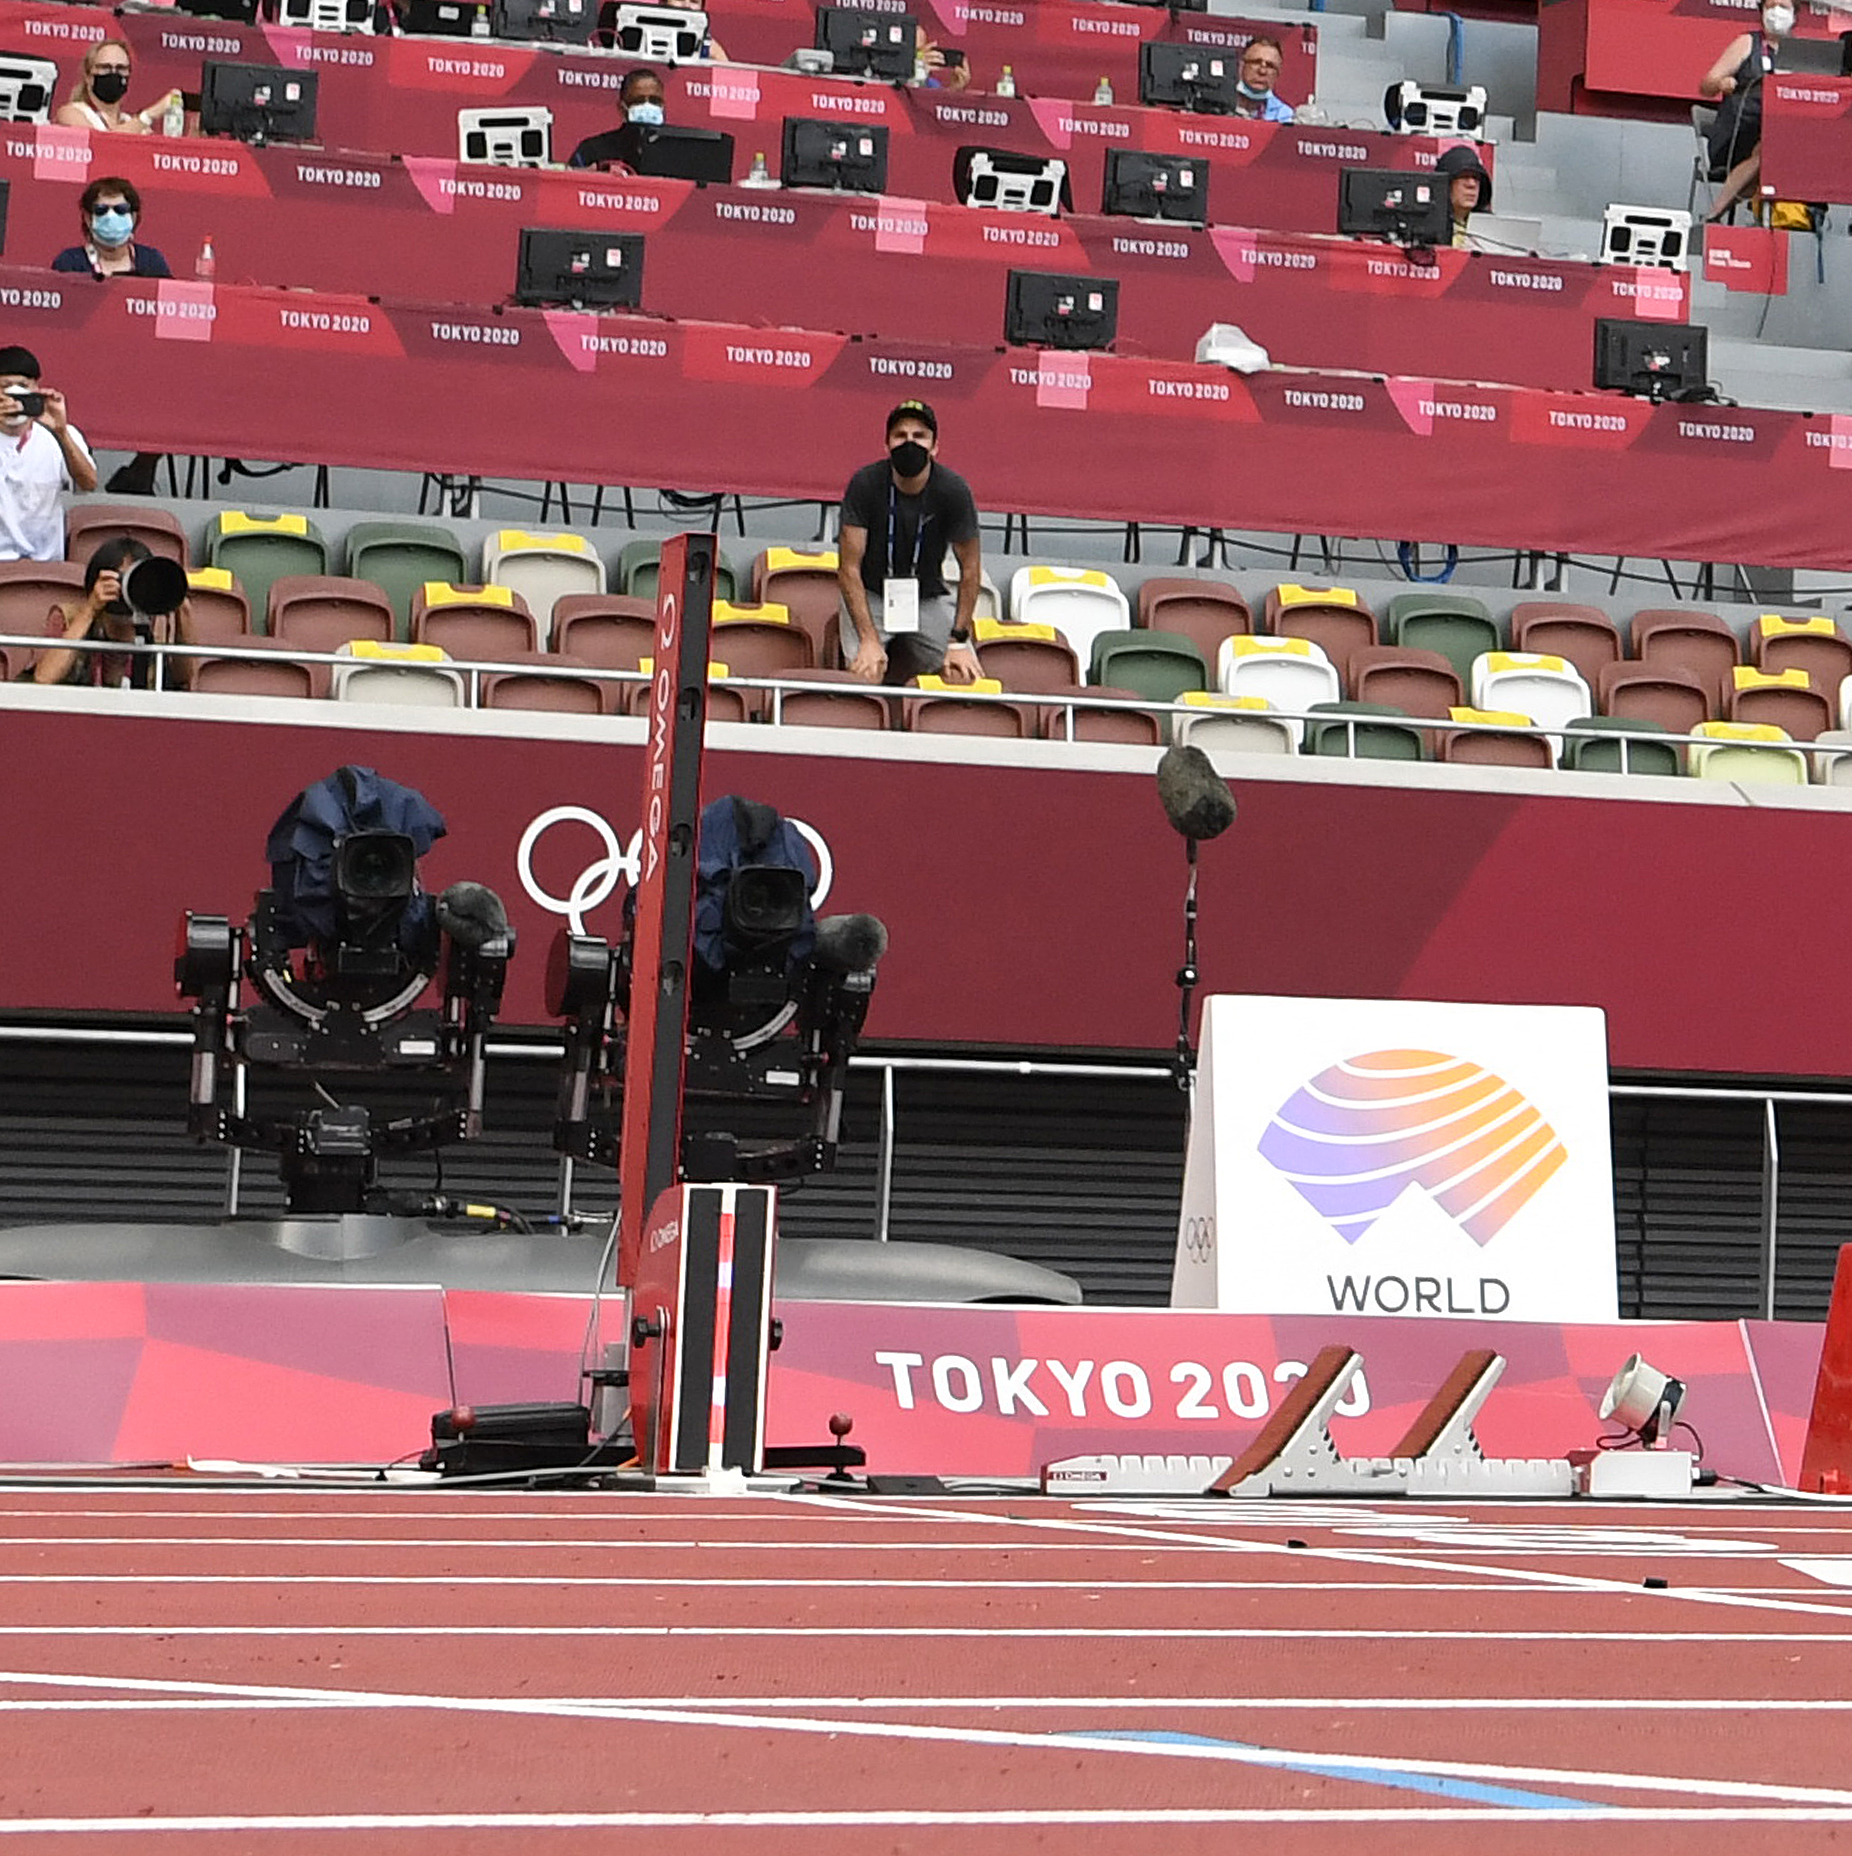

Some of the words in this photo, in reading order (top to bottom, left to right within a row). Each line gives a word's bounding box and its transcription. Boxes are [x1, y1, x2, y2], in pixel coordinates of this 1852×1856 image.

[153, 154, 200, 172] TOKYO
[297, 166, 343, 184] TOKYO
[439, 179, 484, 196] TOKYO
[579, 191, 623, 208] TOKYO
[716, 203, 760, 220] TOKYO
[983, 226, 1025, 243] TOKYO
[1113, 238, 1155, 254] TOKYO
[1241, 249, 1282, 266] TOKYO
[1367, 260, 1407, 276] TOKYO
[1490, 271, 1530, 287] TOKYO
[281, 310, 330, 329] TOKYO
[332, 315, 369, 332] 2020
[432, 323, 480, 341] TOKYO
[483, 327, 519, 344] 2020
[581, 335, 628, 353] TOKYO
[631, 339, 666, 356] 2020
[727, 346, 773, 364] TOKYO
[776, 350, 810, 367] 2020
[870, 358, 915, 375] TOKYO
[918, 362, 952, 378] 2020
[1149, 380, 1193, 397] TOKYO
[1196, 384, 1229, 400] 2020
[1284, 390, 1328, 407] TOKYO
[1330, 394, 1363, 410] 2020
[1419, 401, 1461, 418] TOKYO
[1464, 405, 1495, 420] 2020
[1549, 411, 1592, 428] TOKYO
[1594, 415, 1625, 430] 2020
[1679, 422, 1721, 438] TOKYO
[1722, 426, 1754, 441] 2020
[645, 668, 670, 882] OMEGA
[1327, 1275, 1510, 1314] WORLD
[876, 1350, 1151, 1418] TOKYO
